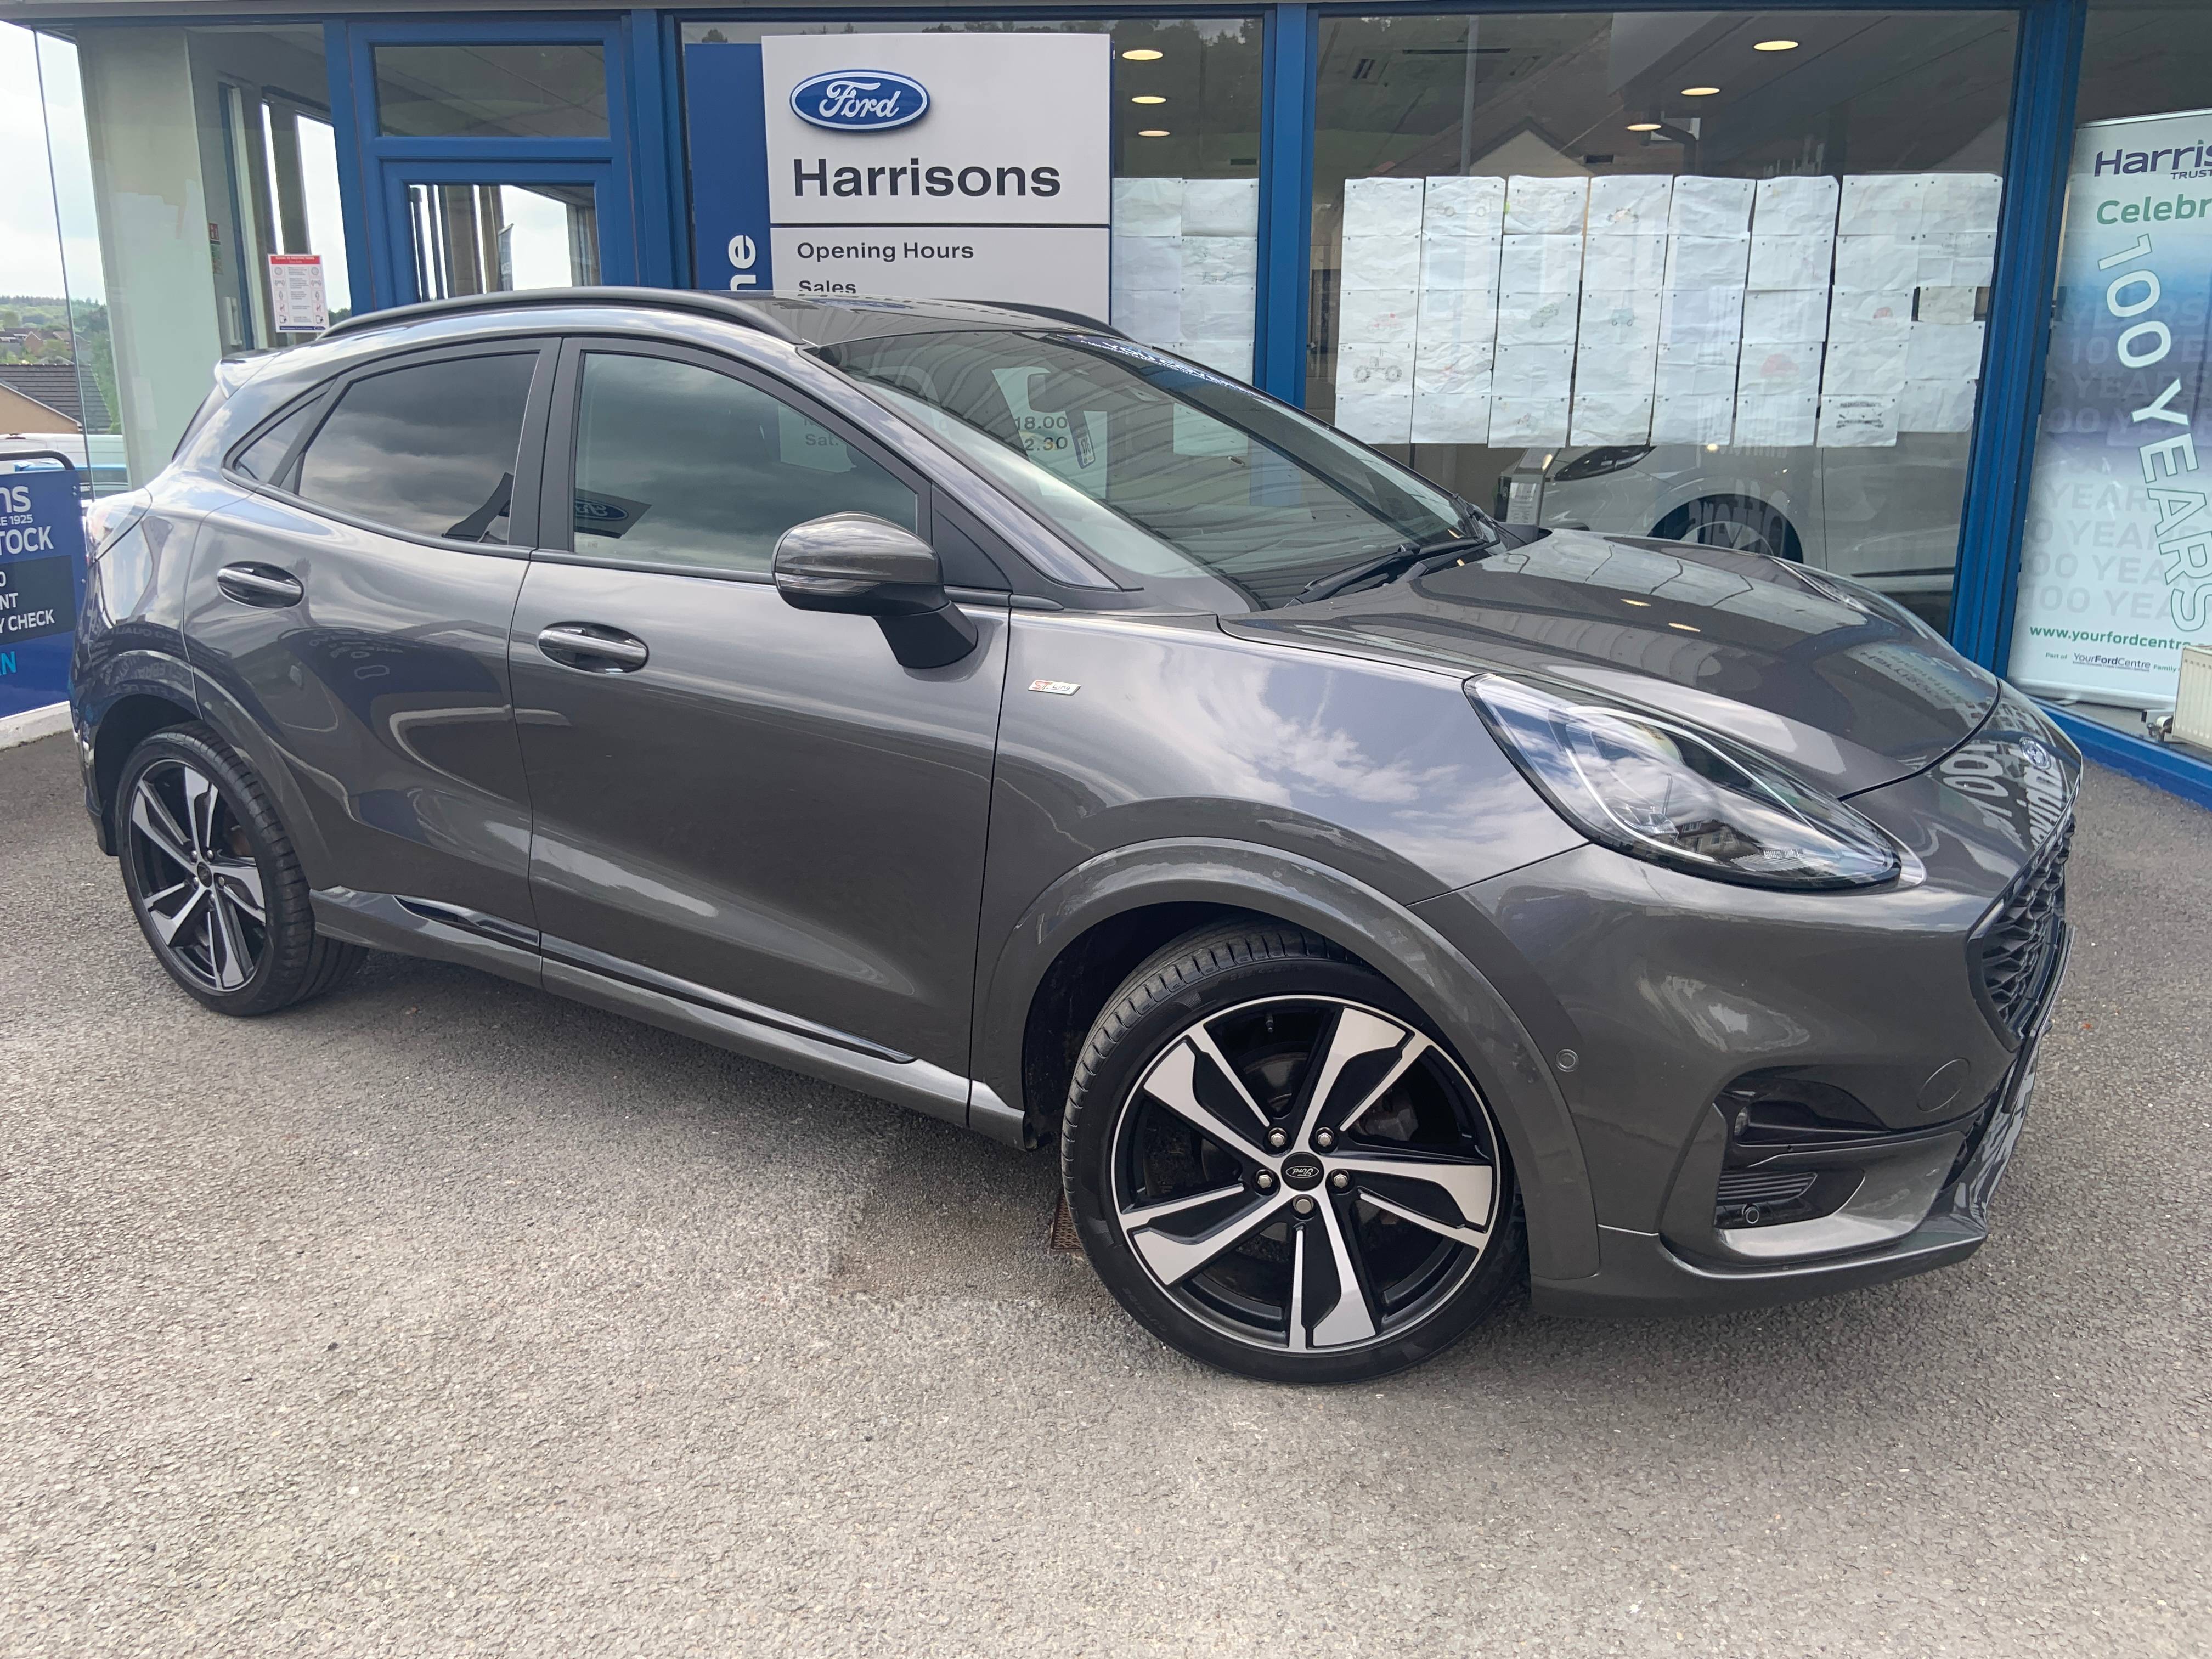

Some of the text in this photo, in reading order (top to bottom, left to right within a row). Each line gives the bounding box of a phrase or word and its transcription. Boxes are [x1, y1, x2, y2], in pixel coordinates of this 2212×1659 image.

[819, 80, 901, 119] Ford
[793, 157, 1061, 198] Harrisons
[797, 242, 974, 262] Opening Hours
[799, 280, 857, 294] Sales
[2097, 233, 2171, 369] 100
[1015, 416, 1068, 430] 18.00
[805, 433, 839, 447] Sat.
[2131, 376, 2212, 632] YEARS
[9, 514, 33, 525] 1925
[8, 609, 55, 631] CHECK
[2073, 652, 2151, 668] YourFordCentre
[2153, 664, 2177, 673] Family
[1032, 681, 1053, 690] ST
[1292, 1168, 1314, 1176] Ford
